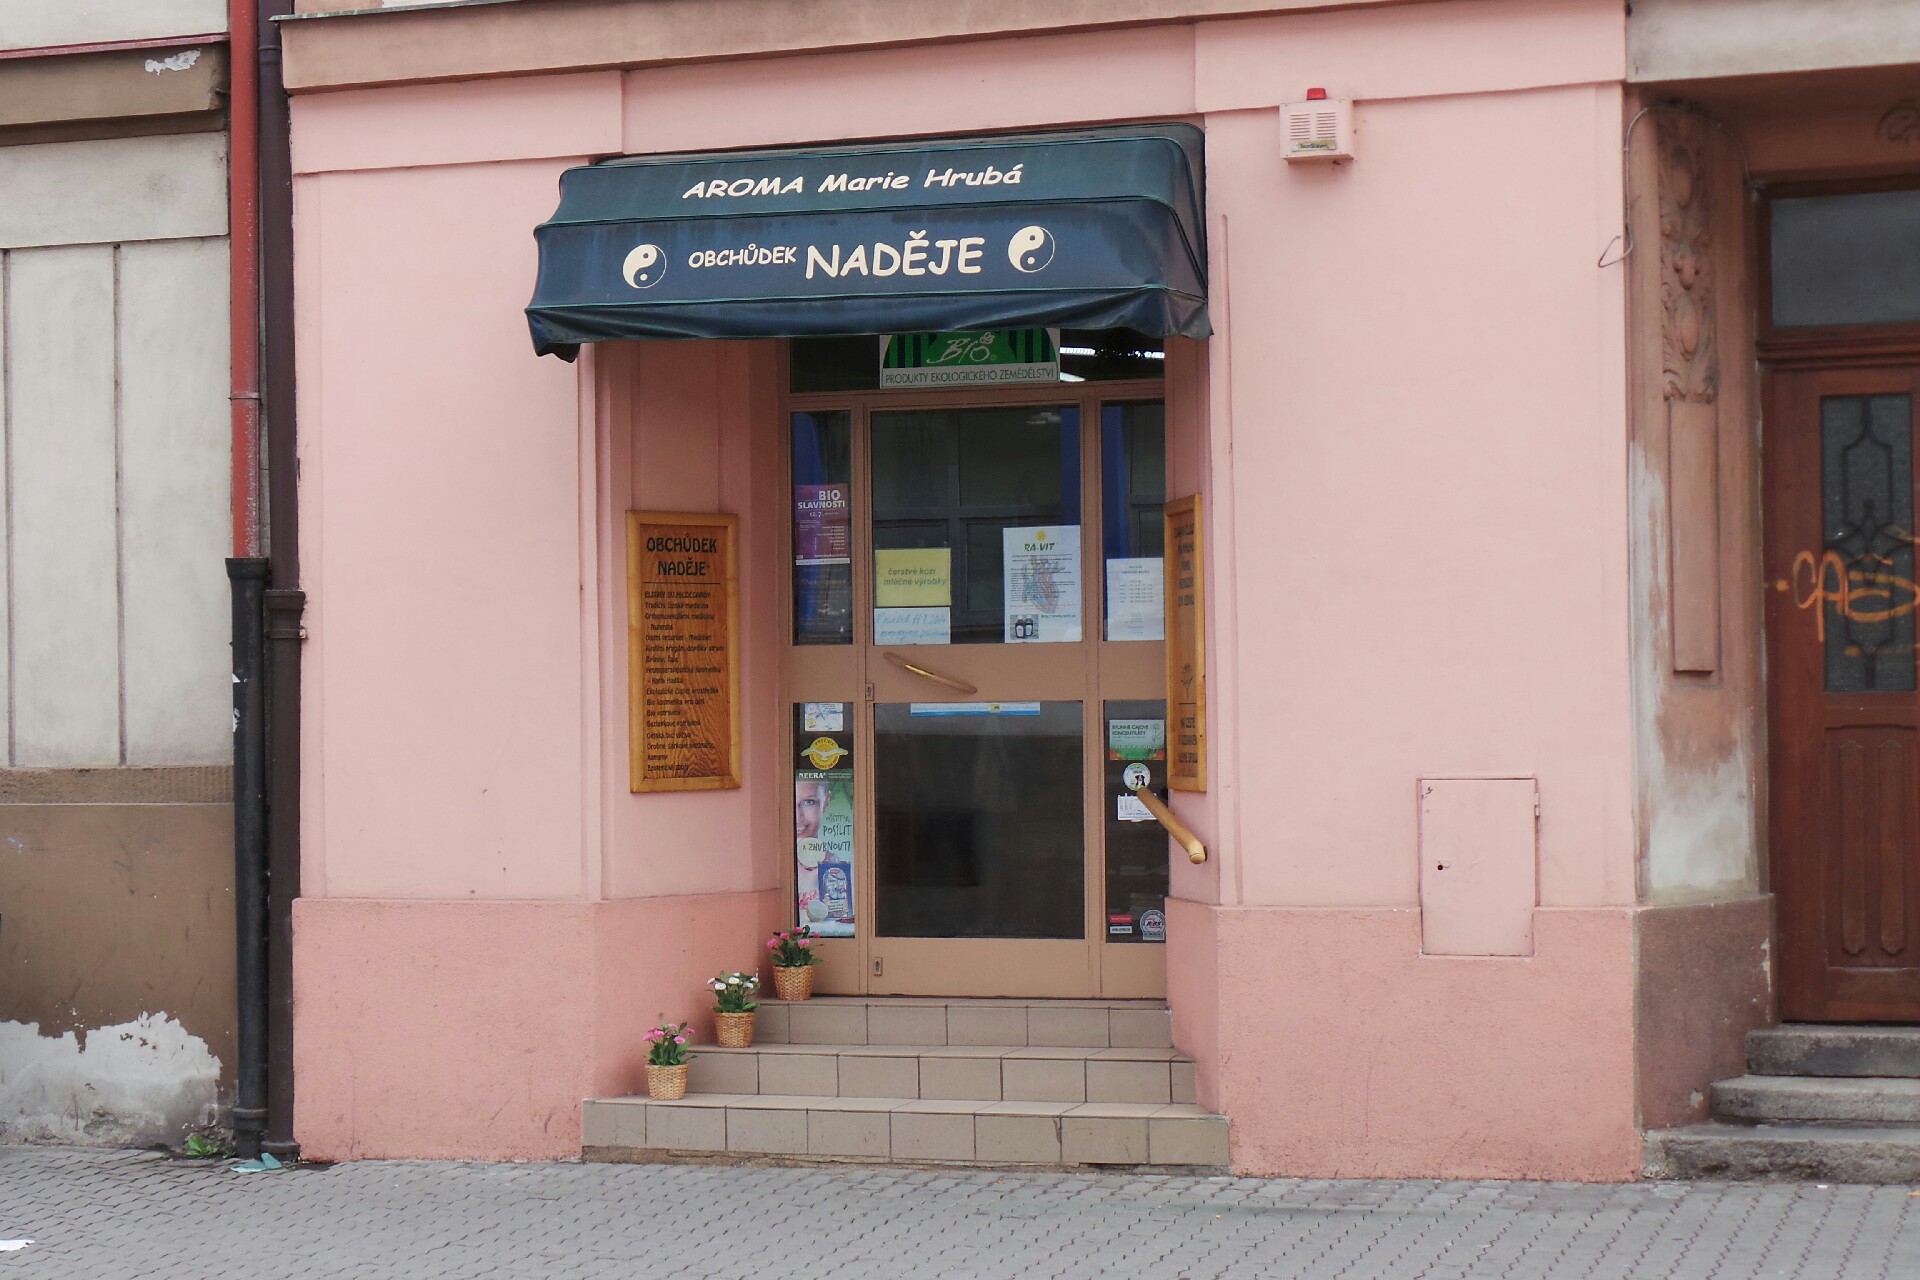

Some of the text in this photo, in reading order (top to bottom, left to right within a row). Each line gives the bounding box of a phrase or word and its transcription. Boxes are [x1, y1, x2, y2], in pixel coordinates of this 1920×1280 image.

[682, 163, 1024, 199] AROMA Marie Hrubá
[688, 229, 986, 279] OBCHŮDEK NADĚJE
[885, 366, 1054, 384] PRODUKTY EKOLOGICKÉHO ZEMĚDĚLSTVÍ
[818, 489, 841, 500] BIO
[797, 500, 846, 509] SLAVNOSTI
[646, 532, 717, 553] OBCHŮDEK
[1024, 542, 1056, 552] RA-VIT
[658, 556, 706, 576] NADĚJE
